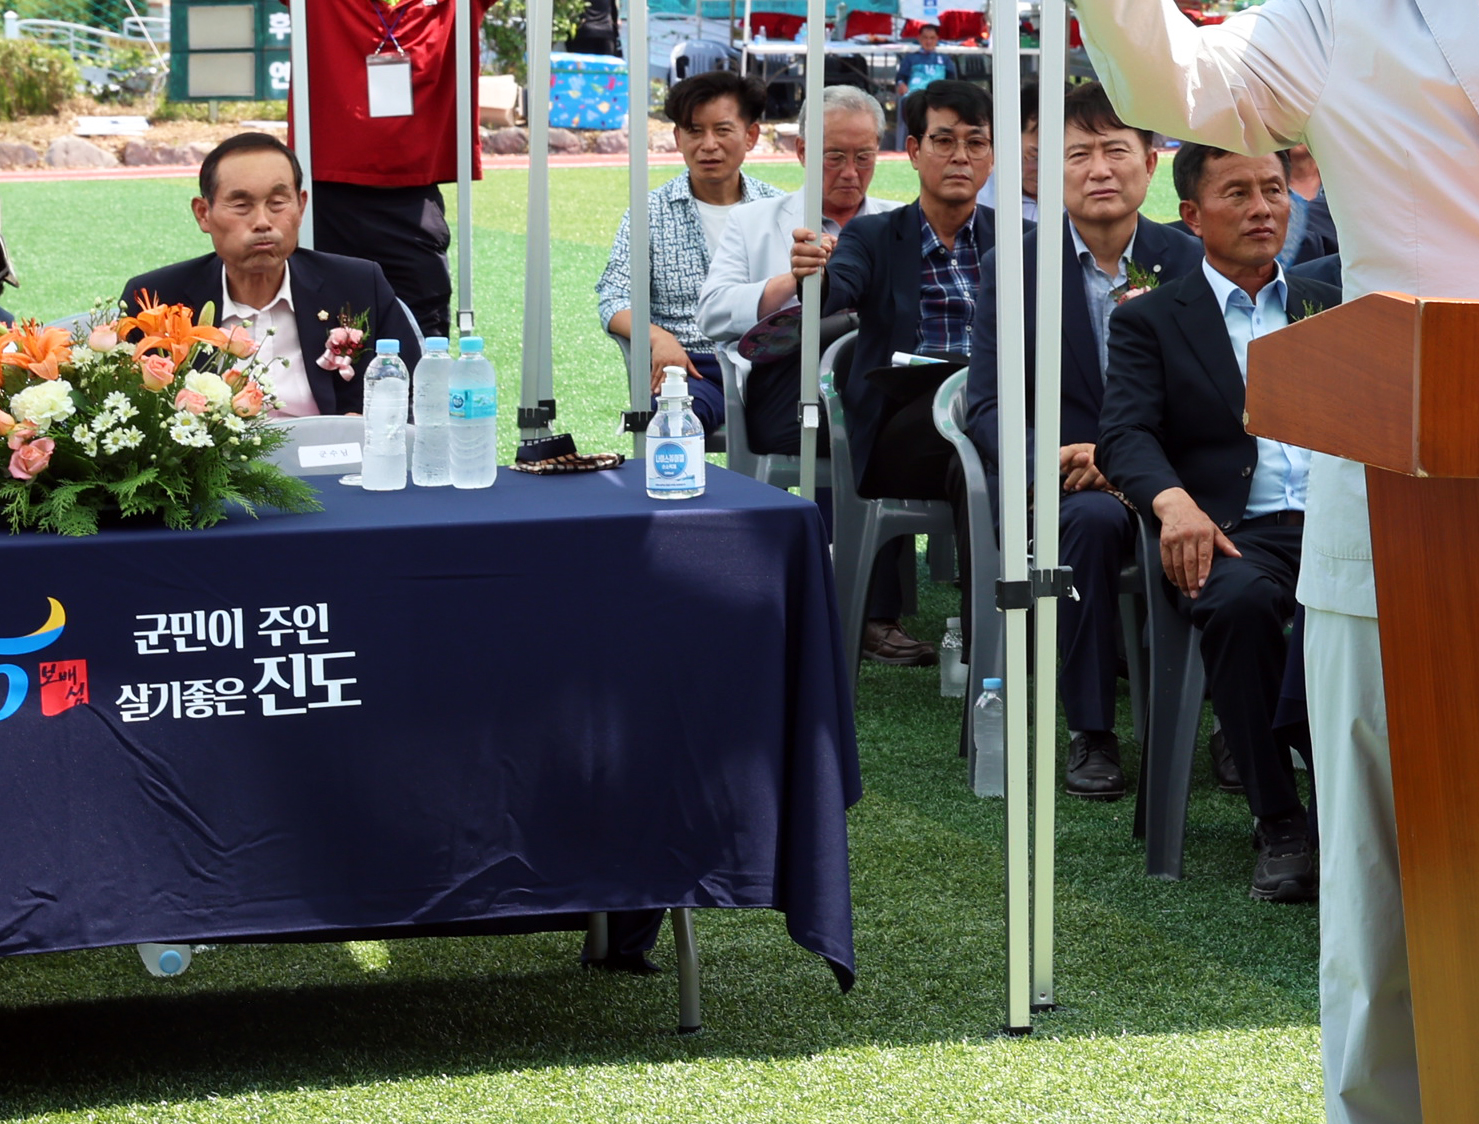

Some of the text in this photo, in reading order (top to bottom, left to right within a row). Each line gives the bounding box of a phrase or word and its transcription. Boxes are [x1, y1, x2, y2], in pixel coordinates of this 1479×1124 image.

[133, 603, 329, 655] 군민이 주인
[115, 651, 362, 723] 살기좋은 진도
